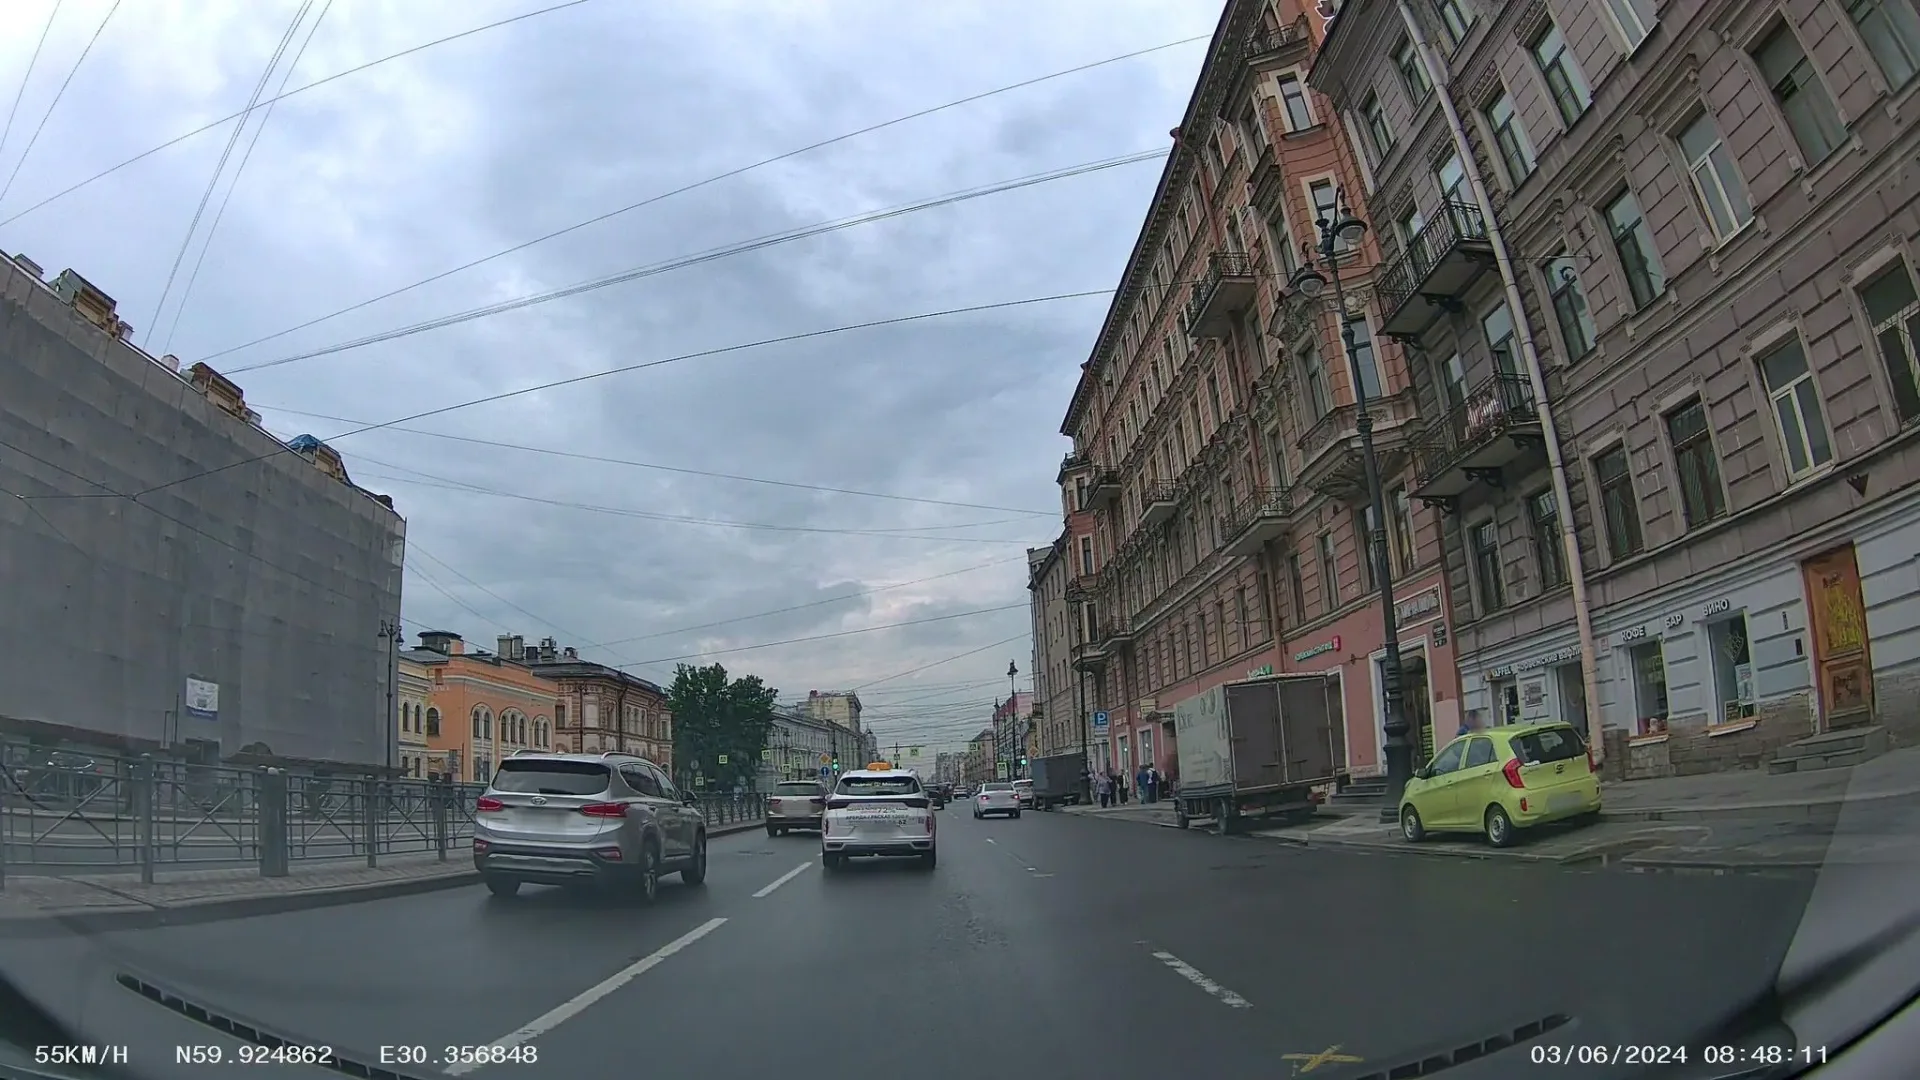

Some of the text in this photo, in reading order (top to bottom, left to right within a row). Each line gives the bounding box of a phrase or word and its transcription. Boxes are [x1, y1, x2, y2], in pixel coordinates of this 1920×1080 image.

[1619, 598, 1729, 642] КОФЕ БАР ВИНО
